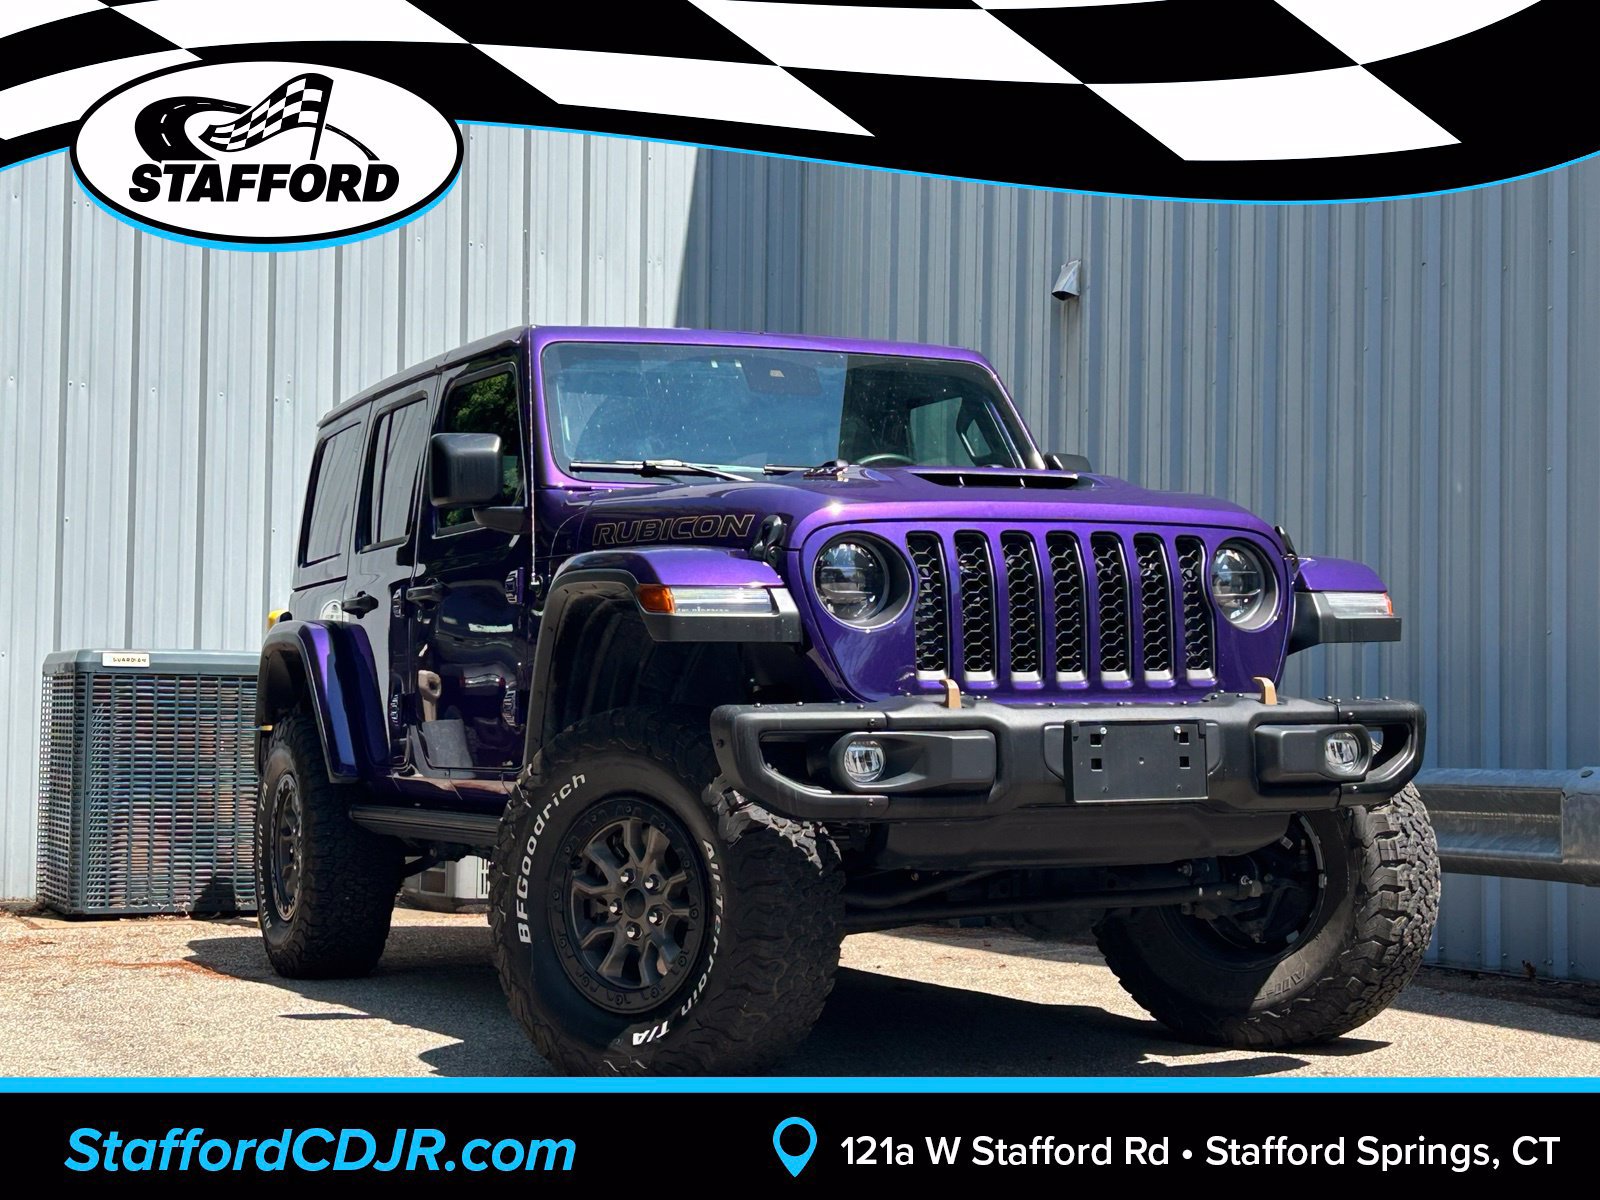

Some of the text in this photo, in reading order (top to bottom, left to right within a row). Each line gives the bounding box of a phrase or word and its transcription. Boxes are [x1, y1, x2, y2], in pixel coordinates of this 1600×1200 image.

[592, 514, 756, 546] RUBICON
[516, 771, 586, 944] BFGoodrich
[632, 839, 725, 1046] All-Terrain T/A
